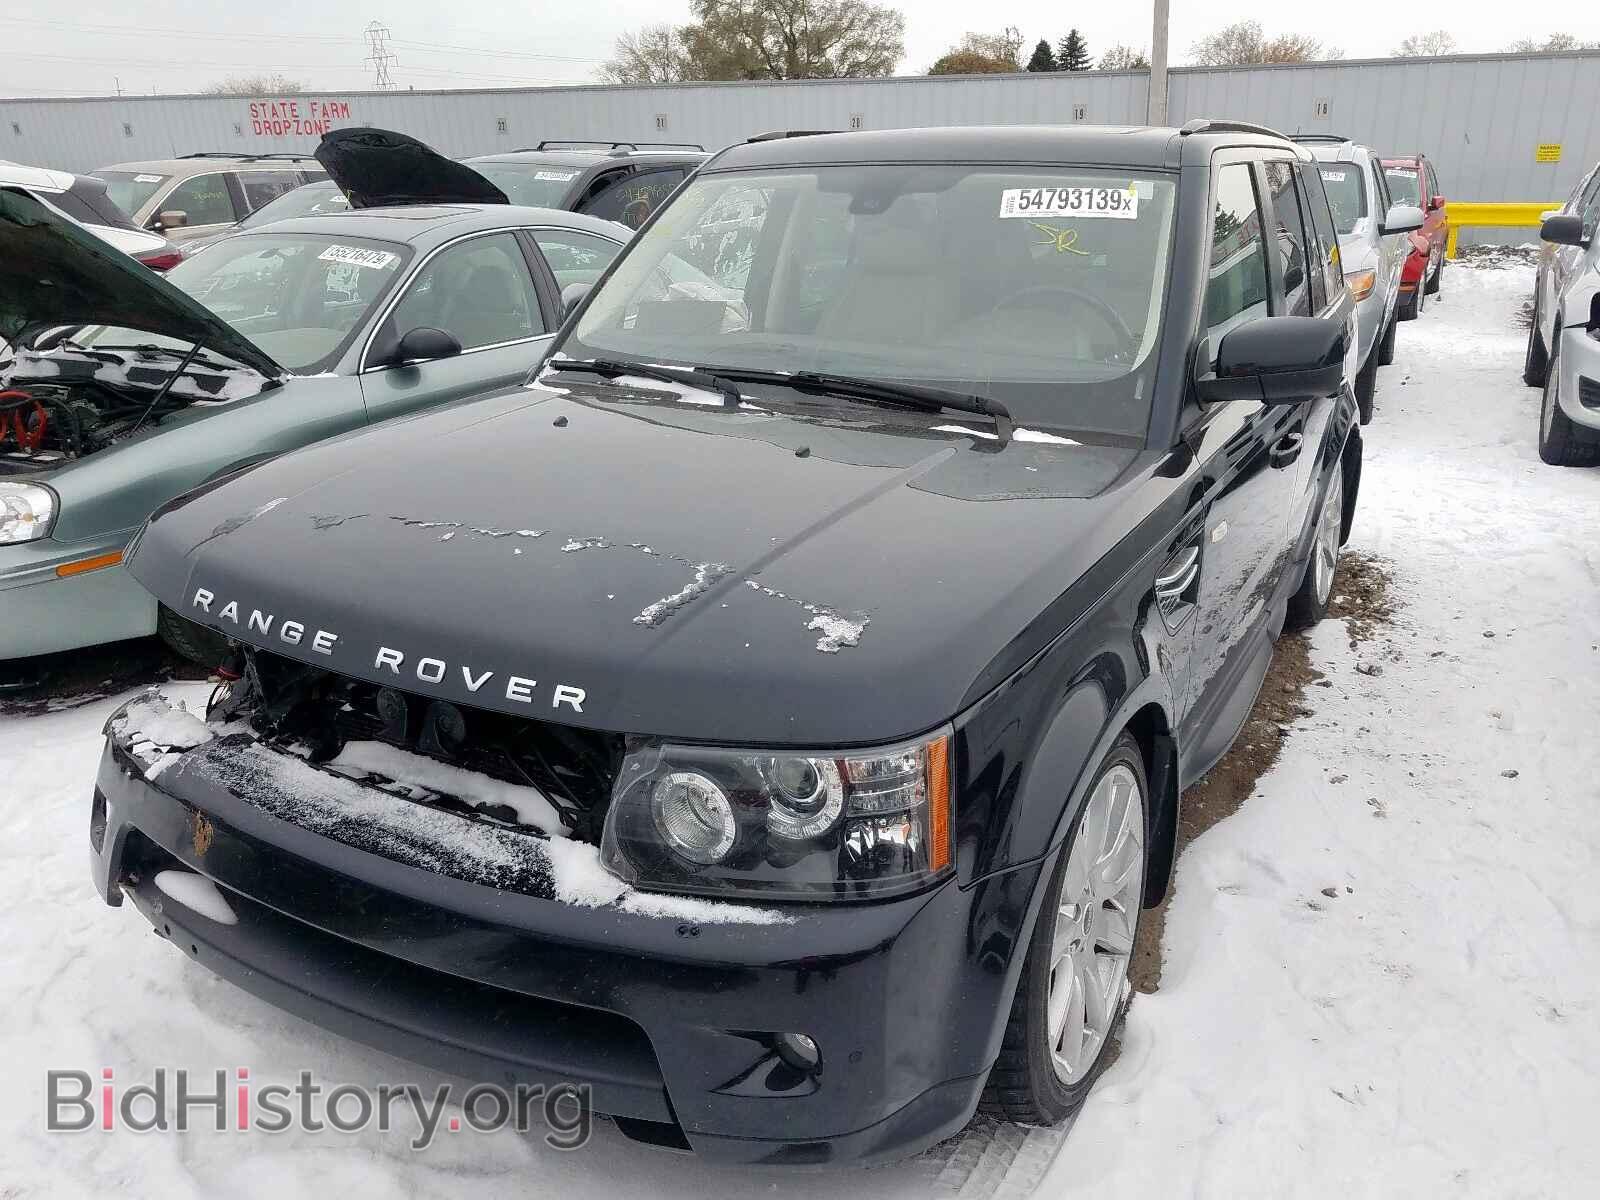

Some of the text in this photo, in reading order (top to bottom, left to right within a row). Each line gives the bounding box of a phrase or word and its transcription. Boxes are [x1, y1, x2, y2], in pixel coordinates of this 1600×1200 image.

[250, 102, 351, 118] STATE FARM
[192, 587, 587, 713] RANGE ROVER
